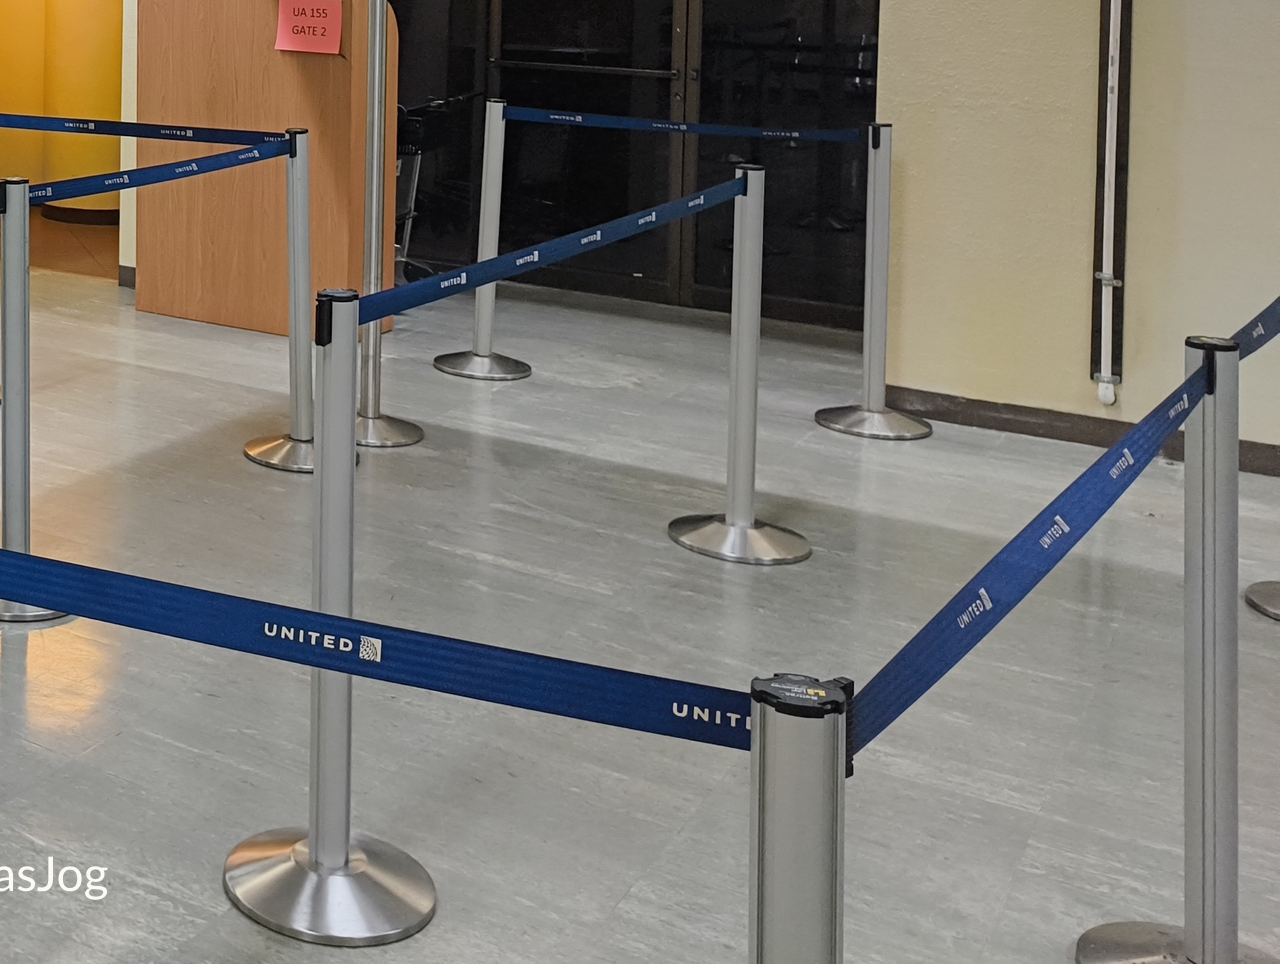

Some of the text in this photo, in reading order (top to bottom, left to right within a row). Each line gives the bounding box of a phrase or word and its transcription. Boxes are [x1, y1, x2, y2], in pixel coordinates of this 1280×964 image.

[293, 8, 328, 18] UA 155
[292, 25, 327, 36] GATE 2
[238, 152, 254, 160] UNITED
[175, 165, 192, 173] UNITED
[104, 177, 124, 185] UNITED
[28, 189, 47, 198] NITED
[637, 215, 652, 225] UNITED
[580, 234, 598, 245] UNITED
[515, 254, 534, 266] UNITED
[440, 276, 461, 288] UNITED
[1108, 456, 1128, 480] UNITED
[1038, 524, 1062, 550] UNITED
[956, 599, 983, 629] UNITED
[263, 621, 354, 653] UNITED
[672, 702, 752, 730] UNIT
